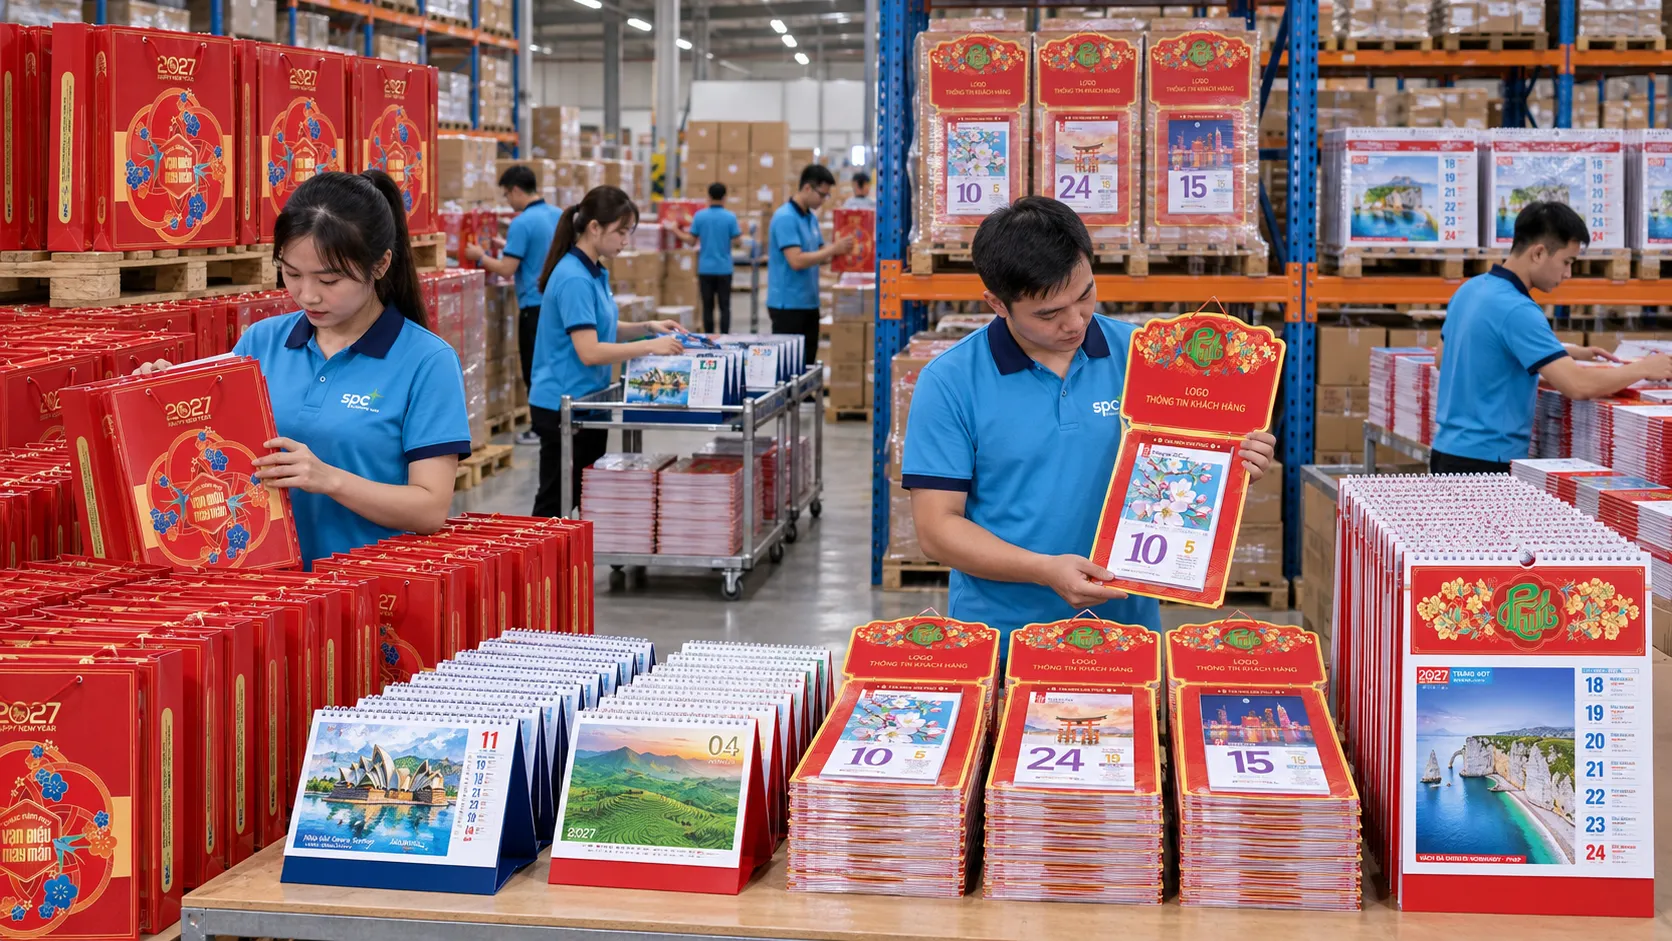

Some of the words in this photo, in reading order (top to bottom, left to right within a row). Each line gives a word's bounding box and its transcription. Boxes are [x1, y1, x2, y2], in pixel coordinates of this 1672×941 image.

[157, 55, 196, 76] 2027
[1444, 159, 1456, 168] 18
[1444, 173, 1456, 182] 19
[1592, 174, 1603, 184] 19
[956, 183, 982, 203] 10
[1059, 175, 1092, 199] 24
[1180, 175, 1207, 198] 15
[1444, 188, 1456, 197] 21
[1444, 201, 1456, 212] 22
[1592, 203, 1603, 213] 22
[1444, 230, 1456, 240] 24
[1592, 231, 1603, 242] 24
[1185, 387, 1209, 397] LOGO
[165, 396, 211, 419] 2027
[341, 393, 370, 408] spc
[1092, 399, 1120, 417] spc
[1146, 395, 1174, 406] THÔNG
[1176, 398, 1189, 407] TIN
[1125, 532, 1168, 565] 10
[1184, 540, 1195, 554] 5
[379, 593, 396, 611] 27
[1419, 669, 1449, 680] 2027
[1585, 677, 1603, 693] 18
[0, 701, 61, 724] 2027
[1585, 705, 1604, 721] 19
[482, 731, 498, 749] 11
[708, 735, 740, 757] 04
[1585, 733, 1605, 749] 20
[850, 746, 893, 766] 10
[914, 750, 926, 759] 5
[1027, 747, 1085, 772] 24
[1105, 754, 1121, 763] 19
[1227, 750, 1274, 774] 15
[476, 760, 486, 770] 19
[1586, 761, 1604, 777] 21
[1585, 788, 1605, 805] 22
[1586, 816, 1605, 833] 23
[567, 828, 596, 839] 2027
[1586, 844, 1606, 860] 24
